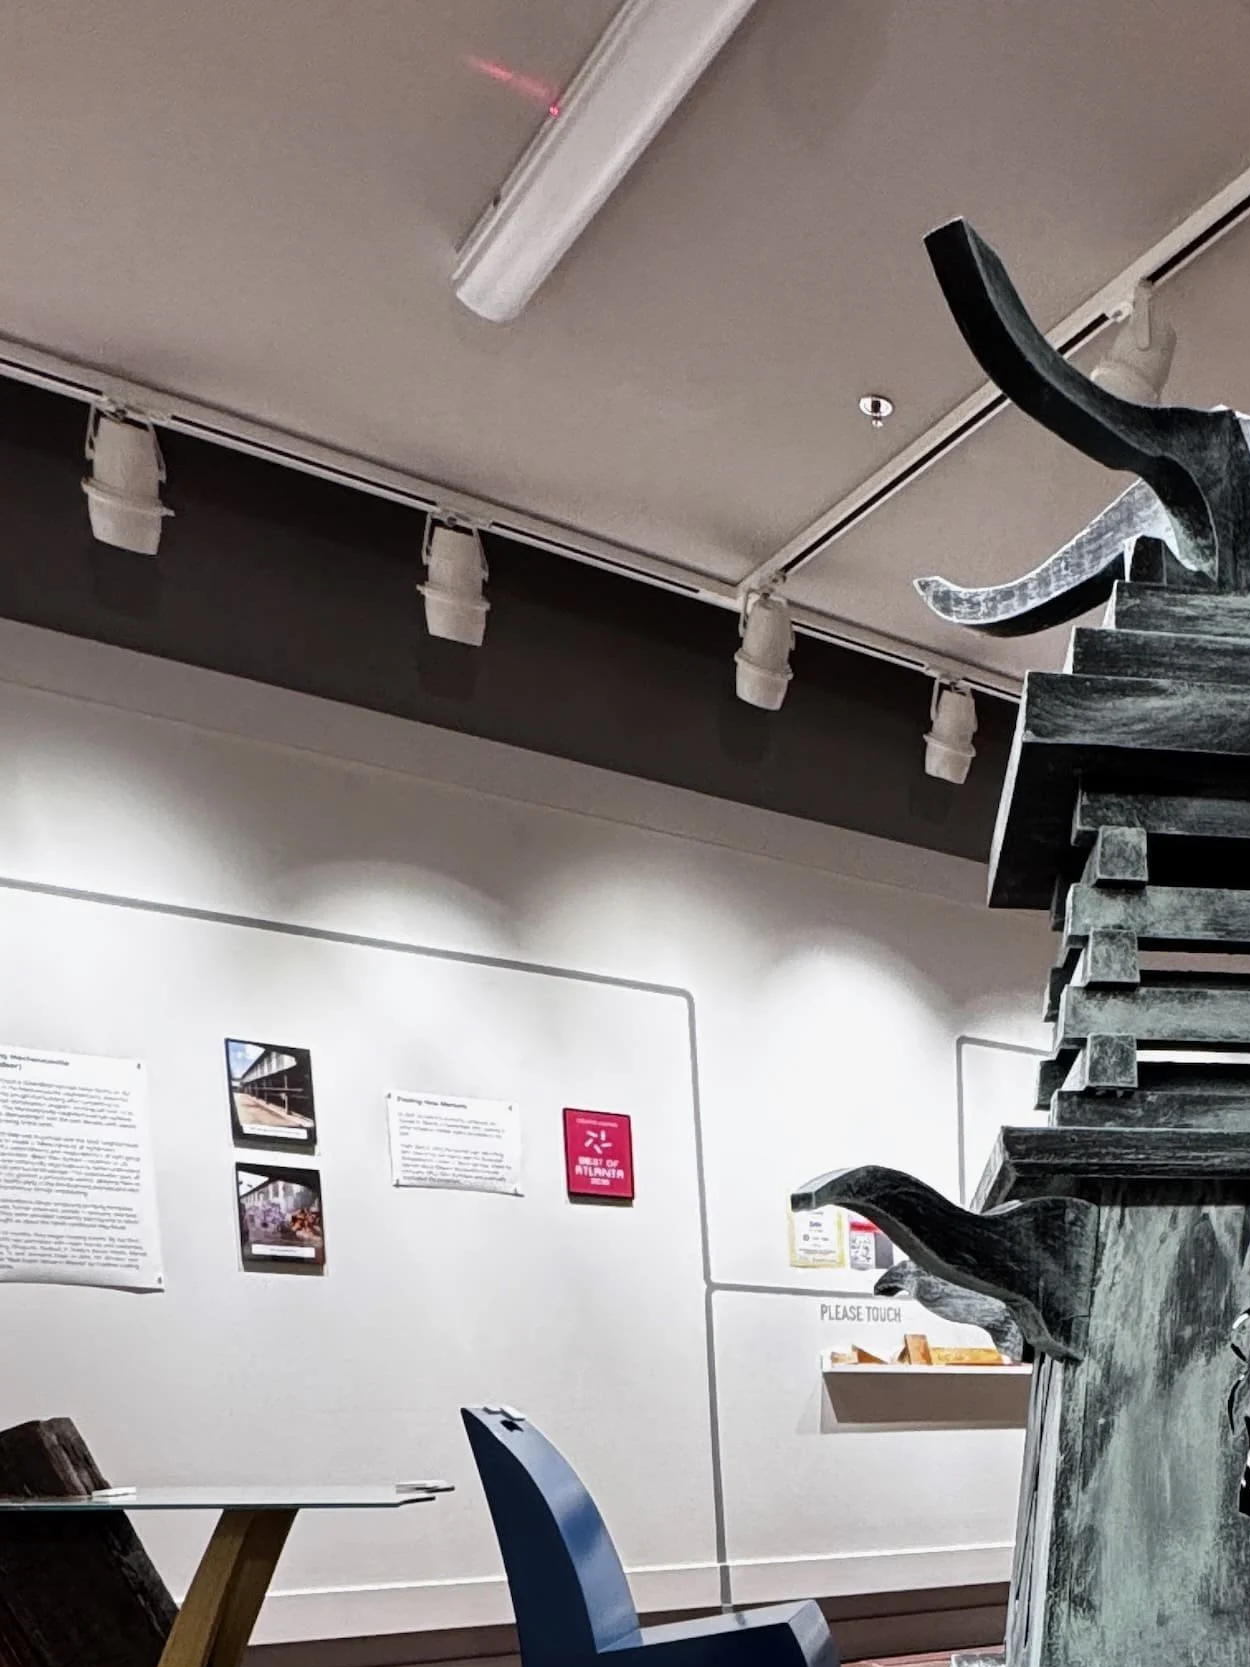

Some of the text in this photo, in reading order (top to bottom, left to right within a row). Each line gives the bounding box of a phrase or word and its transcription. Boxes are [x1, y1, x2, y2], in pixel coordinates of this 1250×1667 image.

[578, 1155, 620, 1168] BEST OF
[575, 1165, 625, 1180] ATLANTA
[820, 1303, 902, 1323] PLEASE TOUCH
